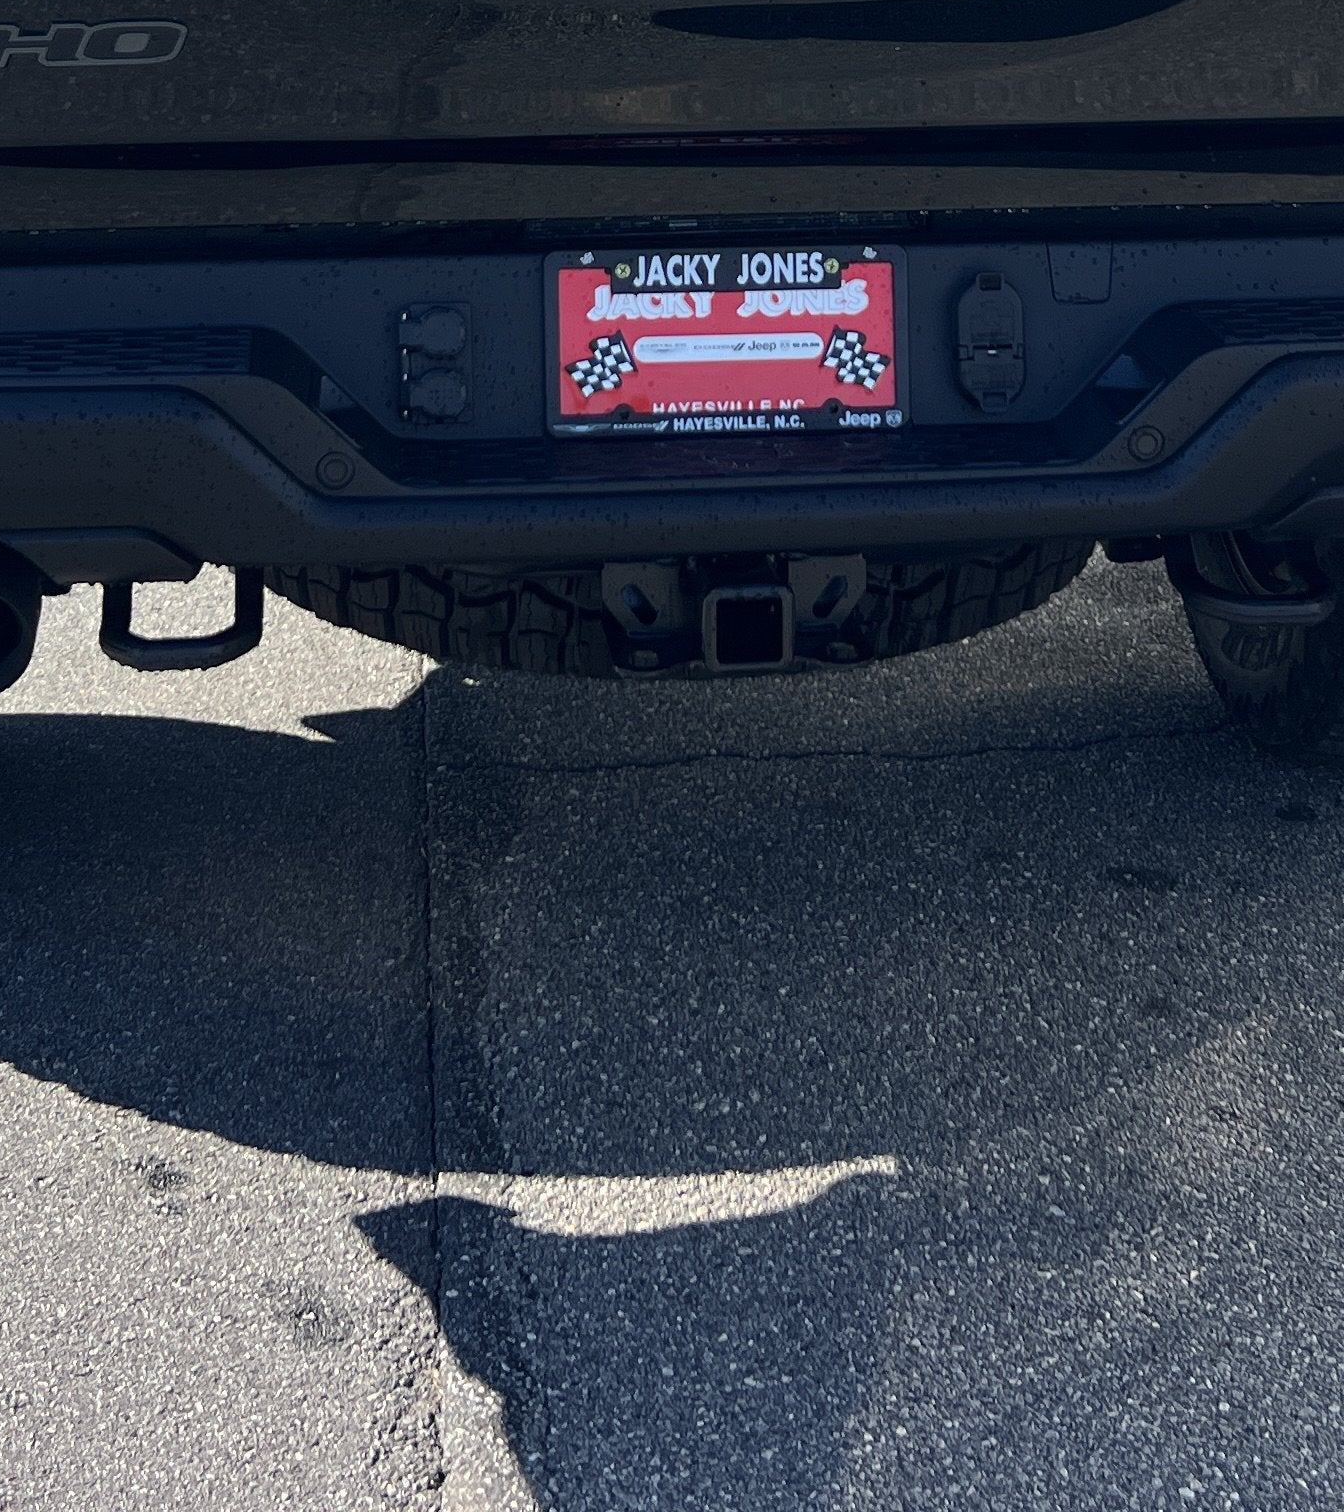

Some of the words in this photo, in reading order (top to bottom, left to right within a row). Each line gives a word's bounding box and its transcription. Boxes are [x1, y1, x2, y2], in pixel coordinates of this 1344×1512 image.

[633, 254, 721, 287] JACKY
[737, 251, 826, 285] JONES
[587, 286, 714, 322] JACKY
[737, 278, 869, 317] JONES
[747, 340, 777, 353] Jeep
[673, 415, 771, 432] HAYESVILLE,
[775, 414, 805, 429] N.C.
[839, 411, 881, 428] Jeep
